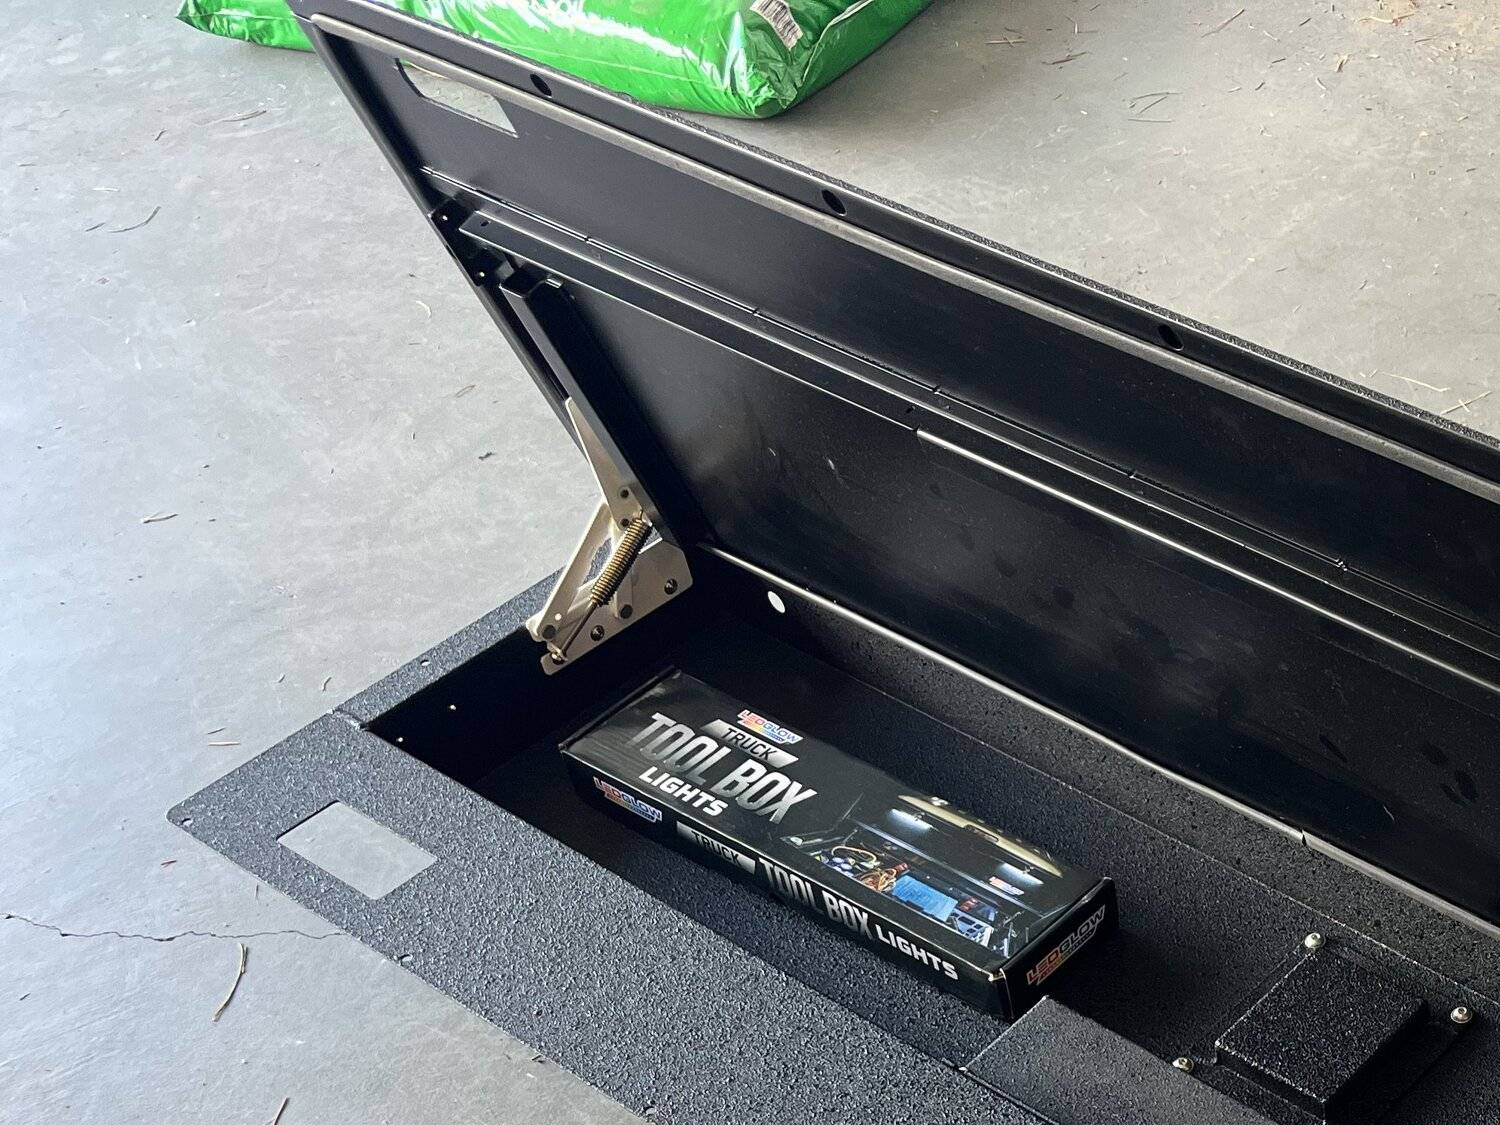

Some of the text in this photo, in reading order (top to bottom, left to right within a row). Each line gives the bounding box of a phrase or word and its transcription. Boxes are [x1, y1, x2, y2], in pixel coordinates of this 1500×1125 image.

[623, 710, 819, 828] TOOL BOX
[720, 726, 778, 761] TRUCK
[637, 762, 729, 819] LIGHTS
[690, 829, 961, 982] TRUCK TOOL BOX LIGHTS
